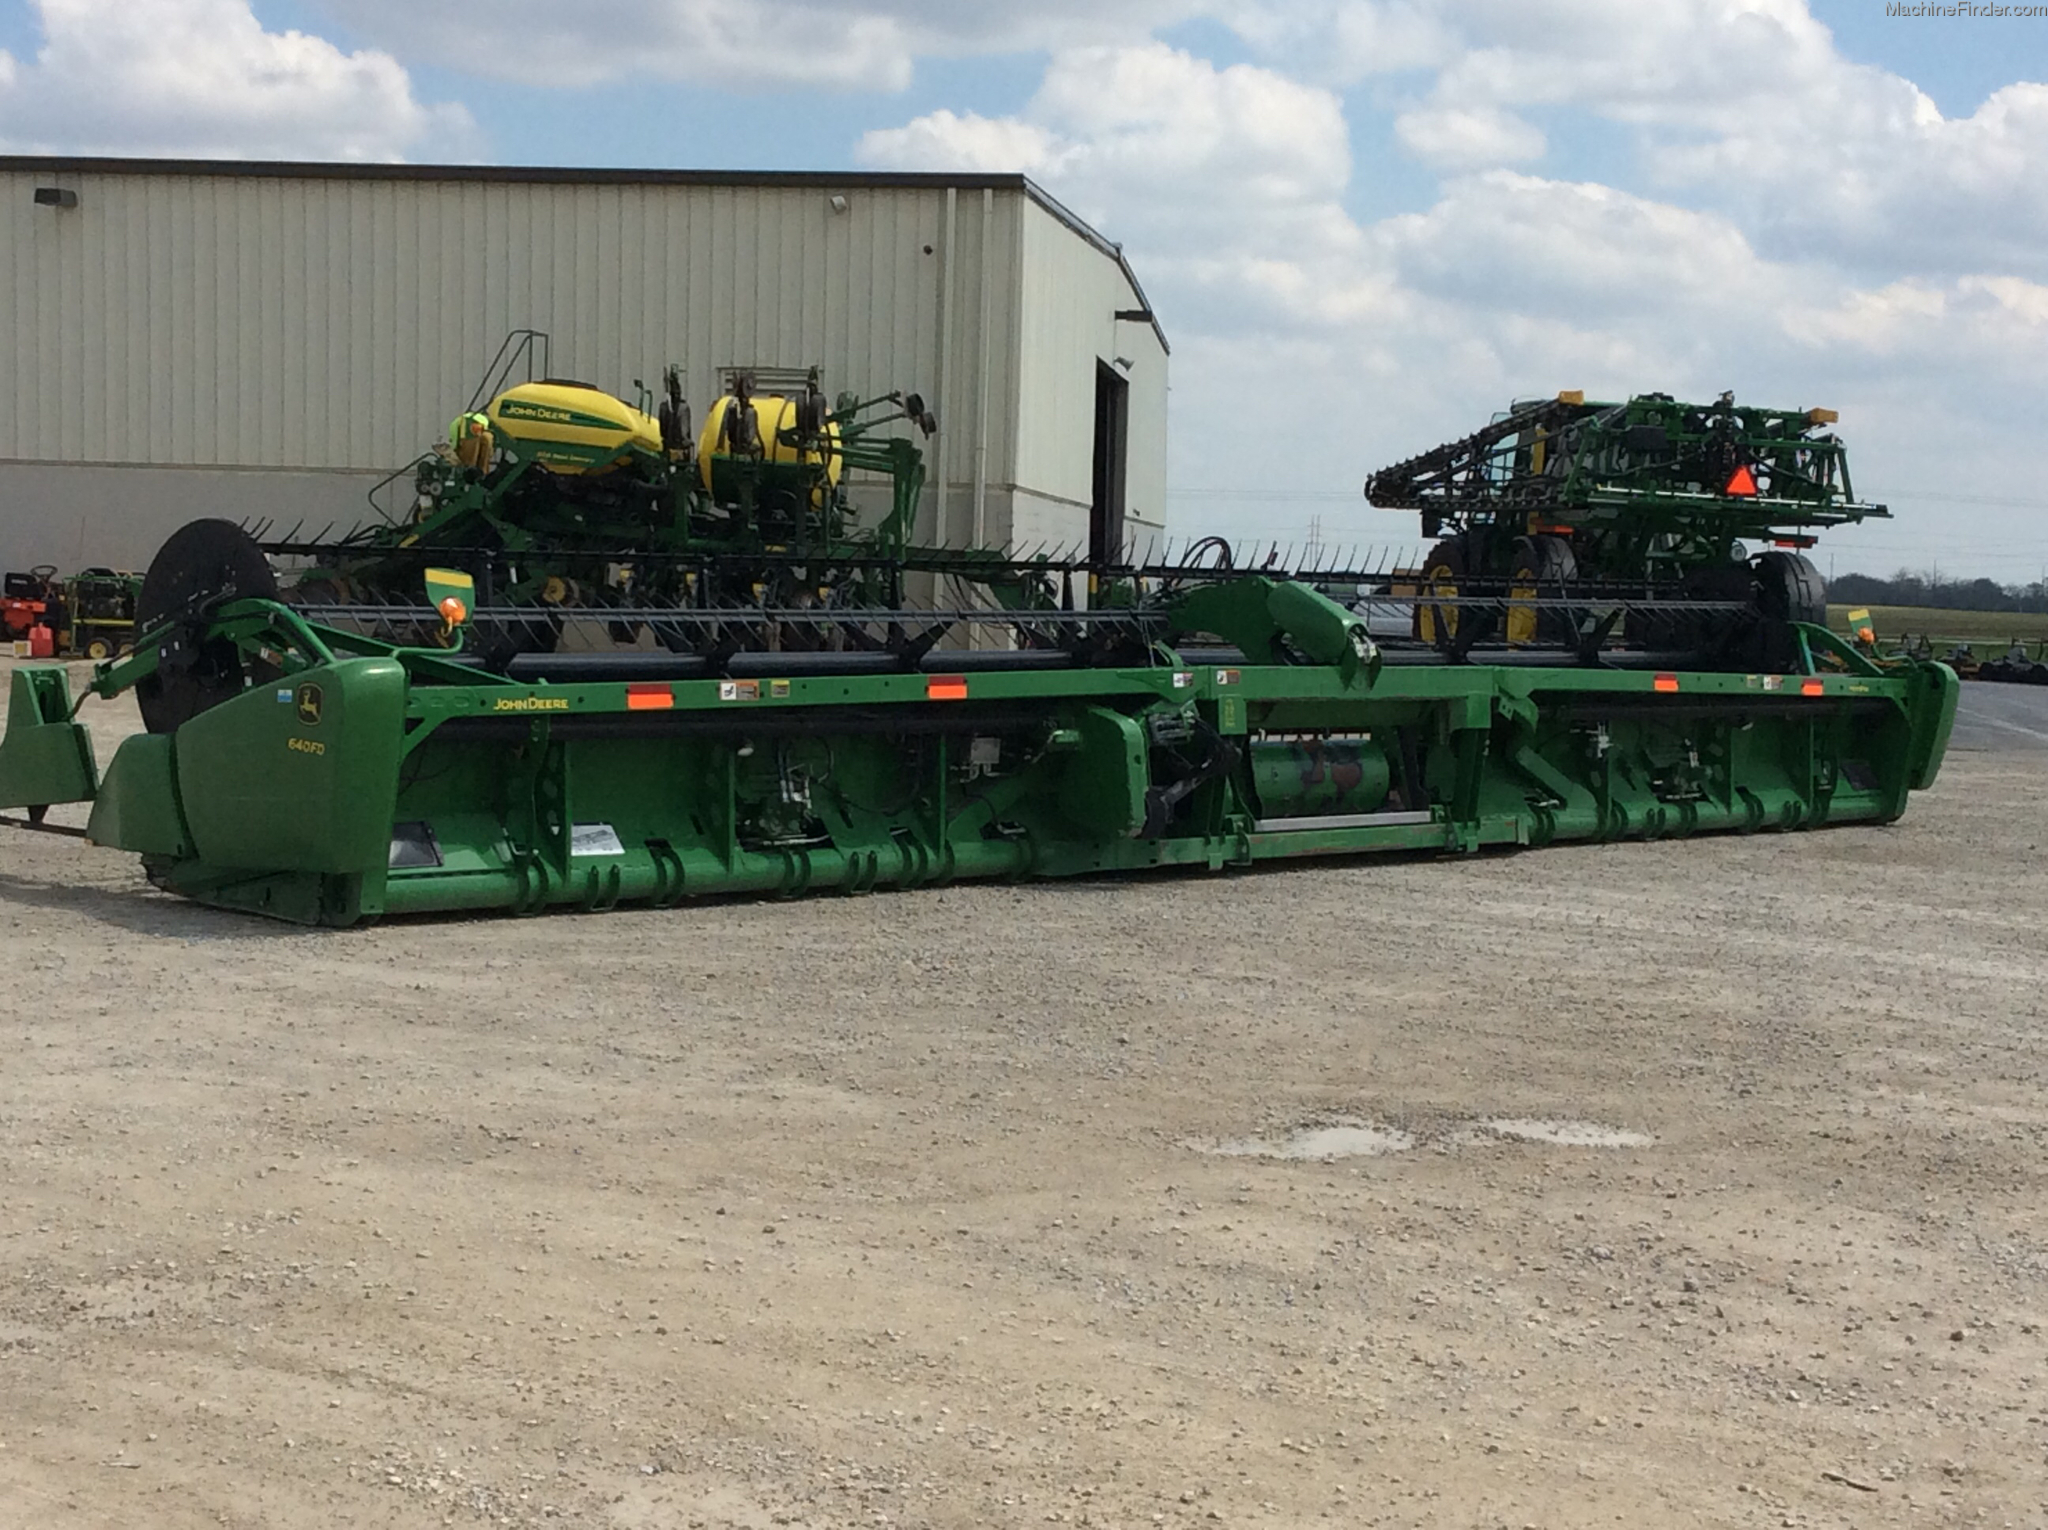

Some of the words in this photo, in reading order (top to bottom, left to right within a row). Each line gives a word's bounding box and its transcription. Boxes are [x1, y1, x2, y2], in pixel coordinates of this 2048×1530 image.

[506, 404, 536, 416] JOHN
[538, 408, 571, 421] DEERE
[493, 698, 528, 710] JOHN
[528, 697, 569, 710] DEERE
[288, 738, 325, 755] 640FD
